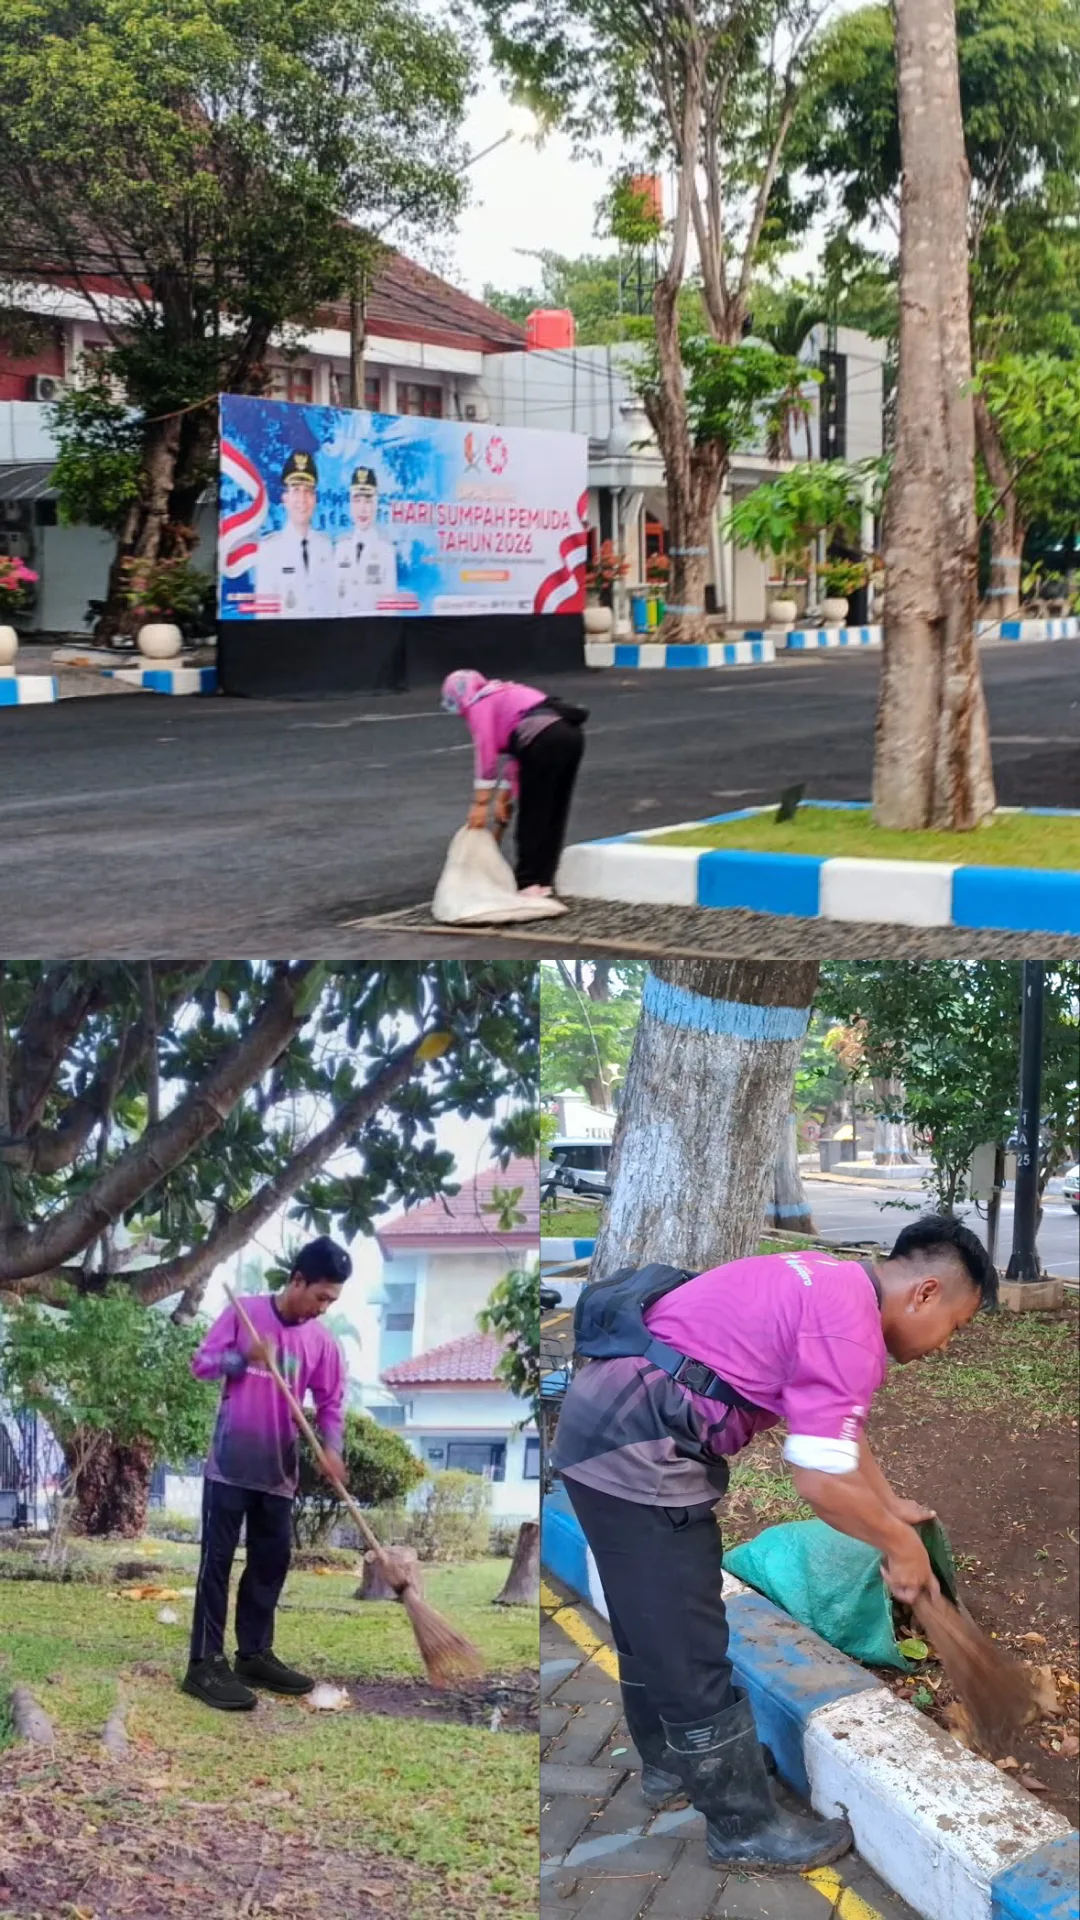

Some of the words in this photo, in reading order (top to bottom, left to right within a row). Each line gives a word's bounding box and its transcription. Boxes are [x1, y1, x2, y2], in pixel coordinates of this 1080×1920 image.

[391, 502, 433, 524] HARI
[437, 504, 505, 528] SUMPAH
[508, 507, 570, 531] PEMUDA
[438, 530, 492, 552] TAHUN
[495, 532, 532, 554] 2026
[1022, 1112, 1028, 1126] 1
[1019, 1132, 1028, 1146] A
[1017, 1153, 1030, 1167] 25
